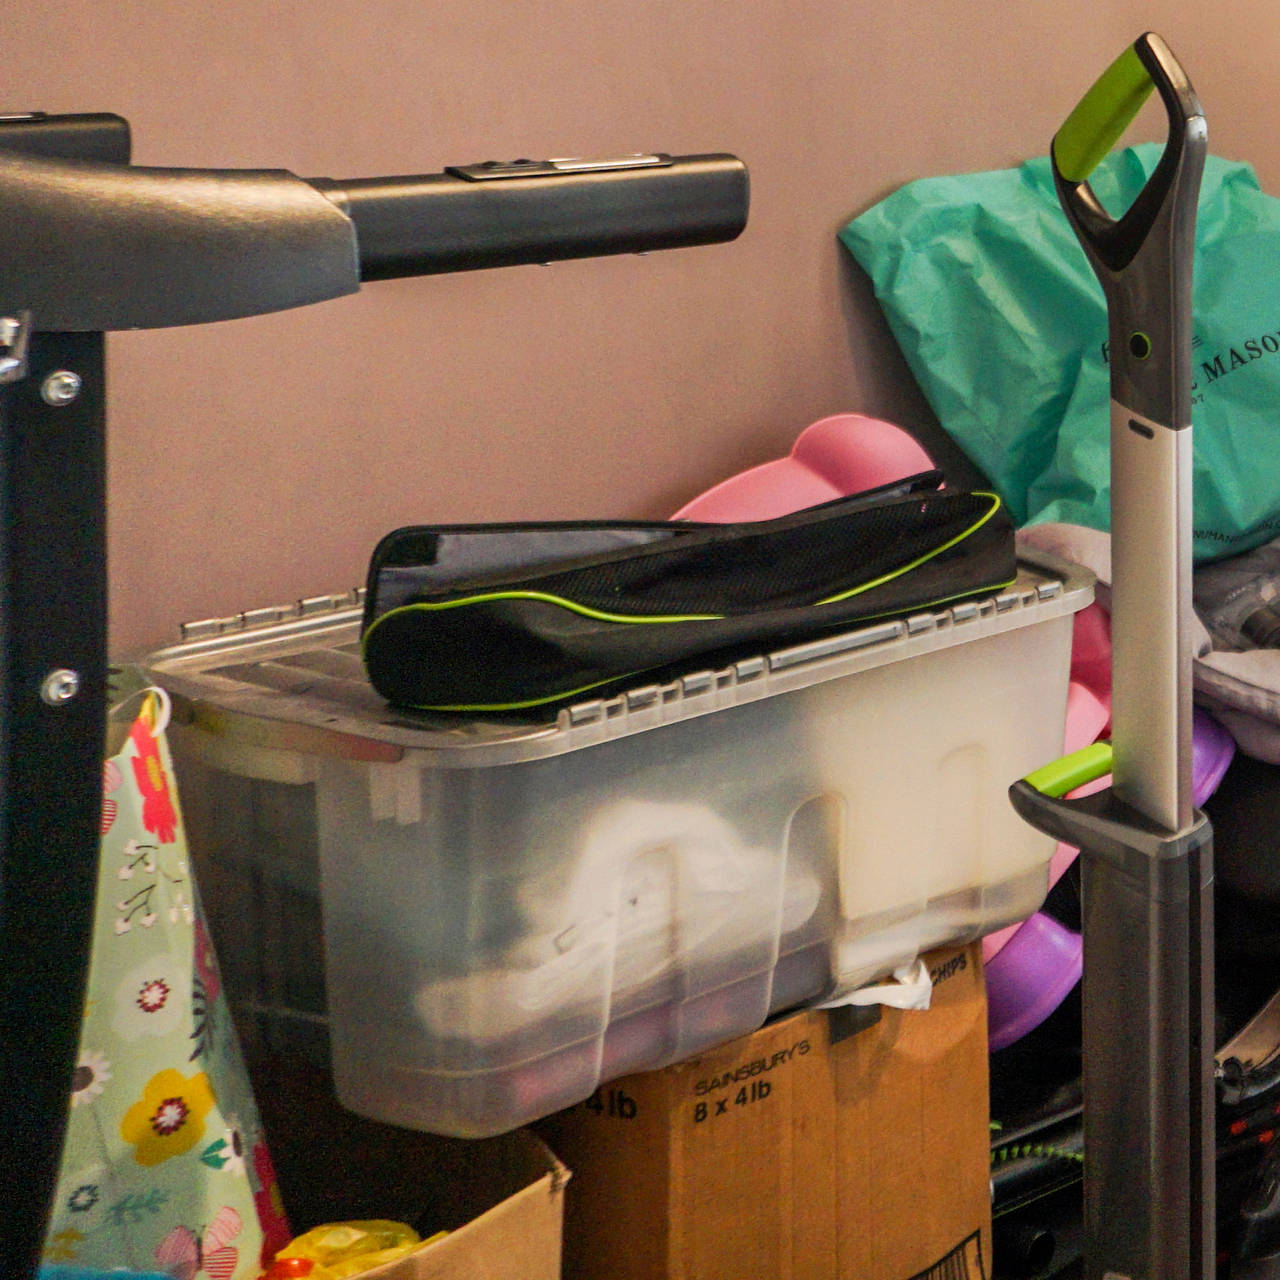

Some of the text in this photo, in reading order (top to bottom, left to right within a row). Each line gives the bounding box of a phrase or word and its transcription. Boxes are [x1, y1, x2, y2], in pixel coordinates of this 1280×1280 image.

[930, 953, 967, 987] CHIPS
[694, 1080, 772, 1123] 8 x 4lb
